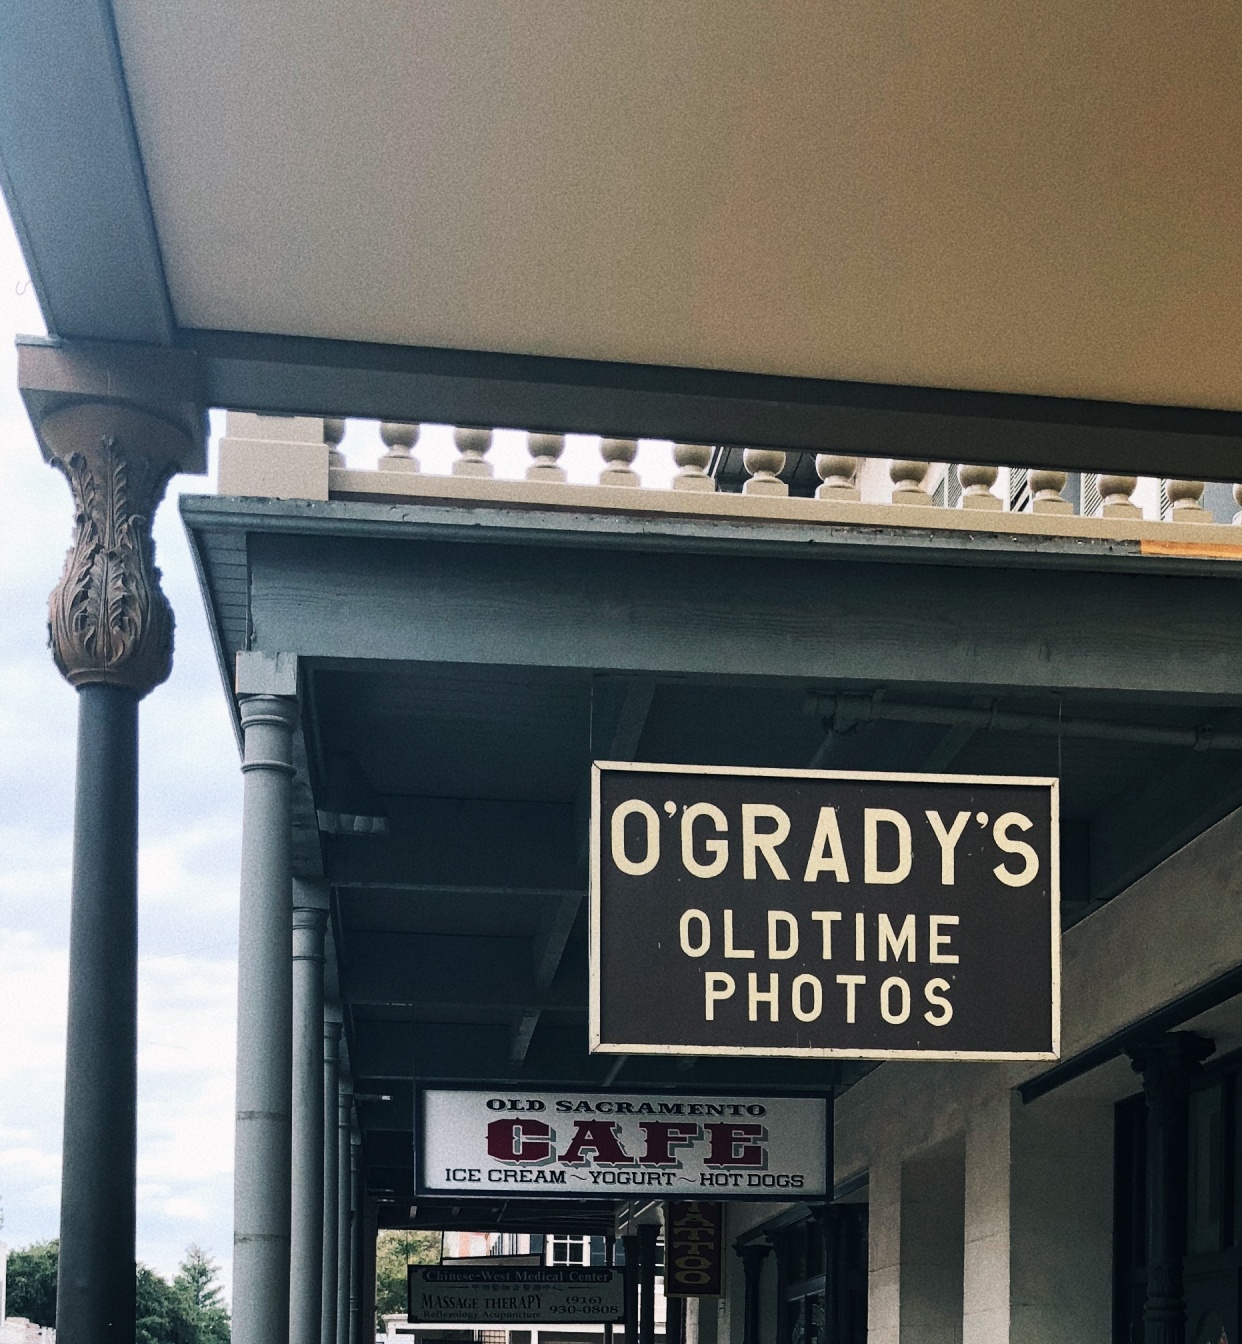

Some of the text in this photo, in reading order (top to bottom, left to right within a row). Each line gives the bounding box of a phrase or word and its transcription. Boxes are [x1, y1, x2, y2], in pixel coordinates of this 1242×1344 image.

[610, 798, 1040, 888] O'GRADY'S
[679, 908, 960, 964] OLDTIME
[704, 971, 954, 1027] PHOTOS
[485, 1098, 767, 1117] OLD SACRAMENTO
[485, 1117, 769, 1171] CAFE
[445, 1168, 805, 1189] ICE CREAM YOGURT HOT DOGS
[426, 1270, 610, 1282] Chinese-West Medical Center
[421, 1293, 544, 1310] MASSAGE THERAPY
[549, 1306, 619, 1315] 930-0808
[565, 1296, 603, 1306] (916)
[482, 1311, 542, 1320] Acupuncture
